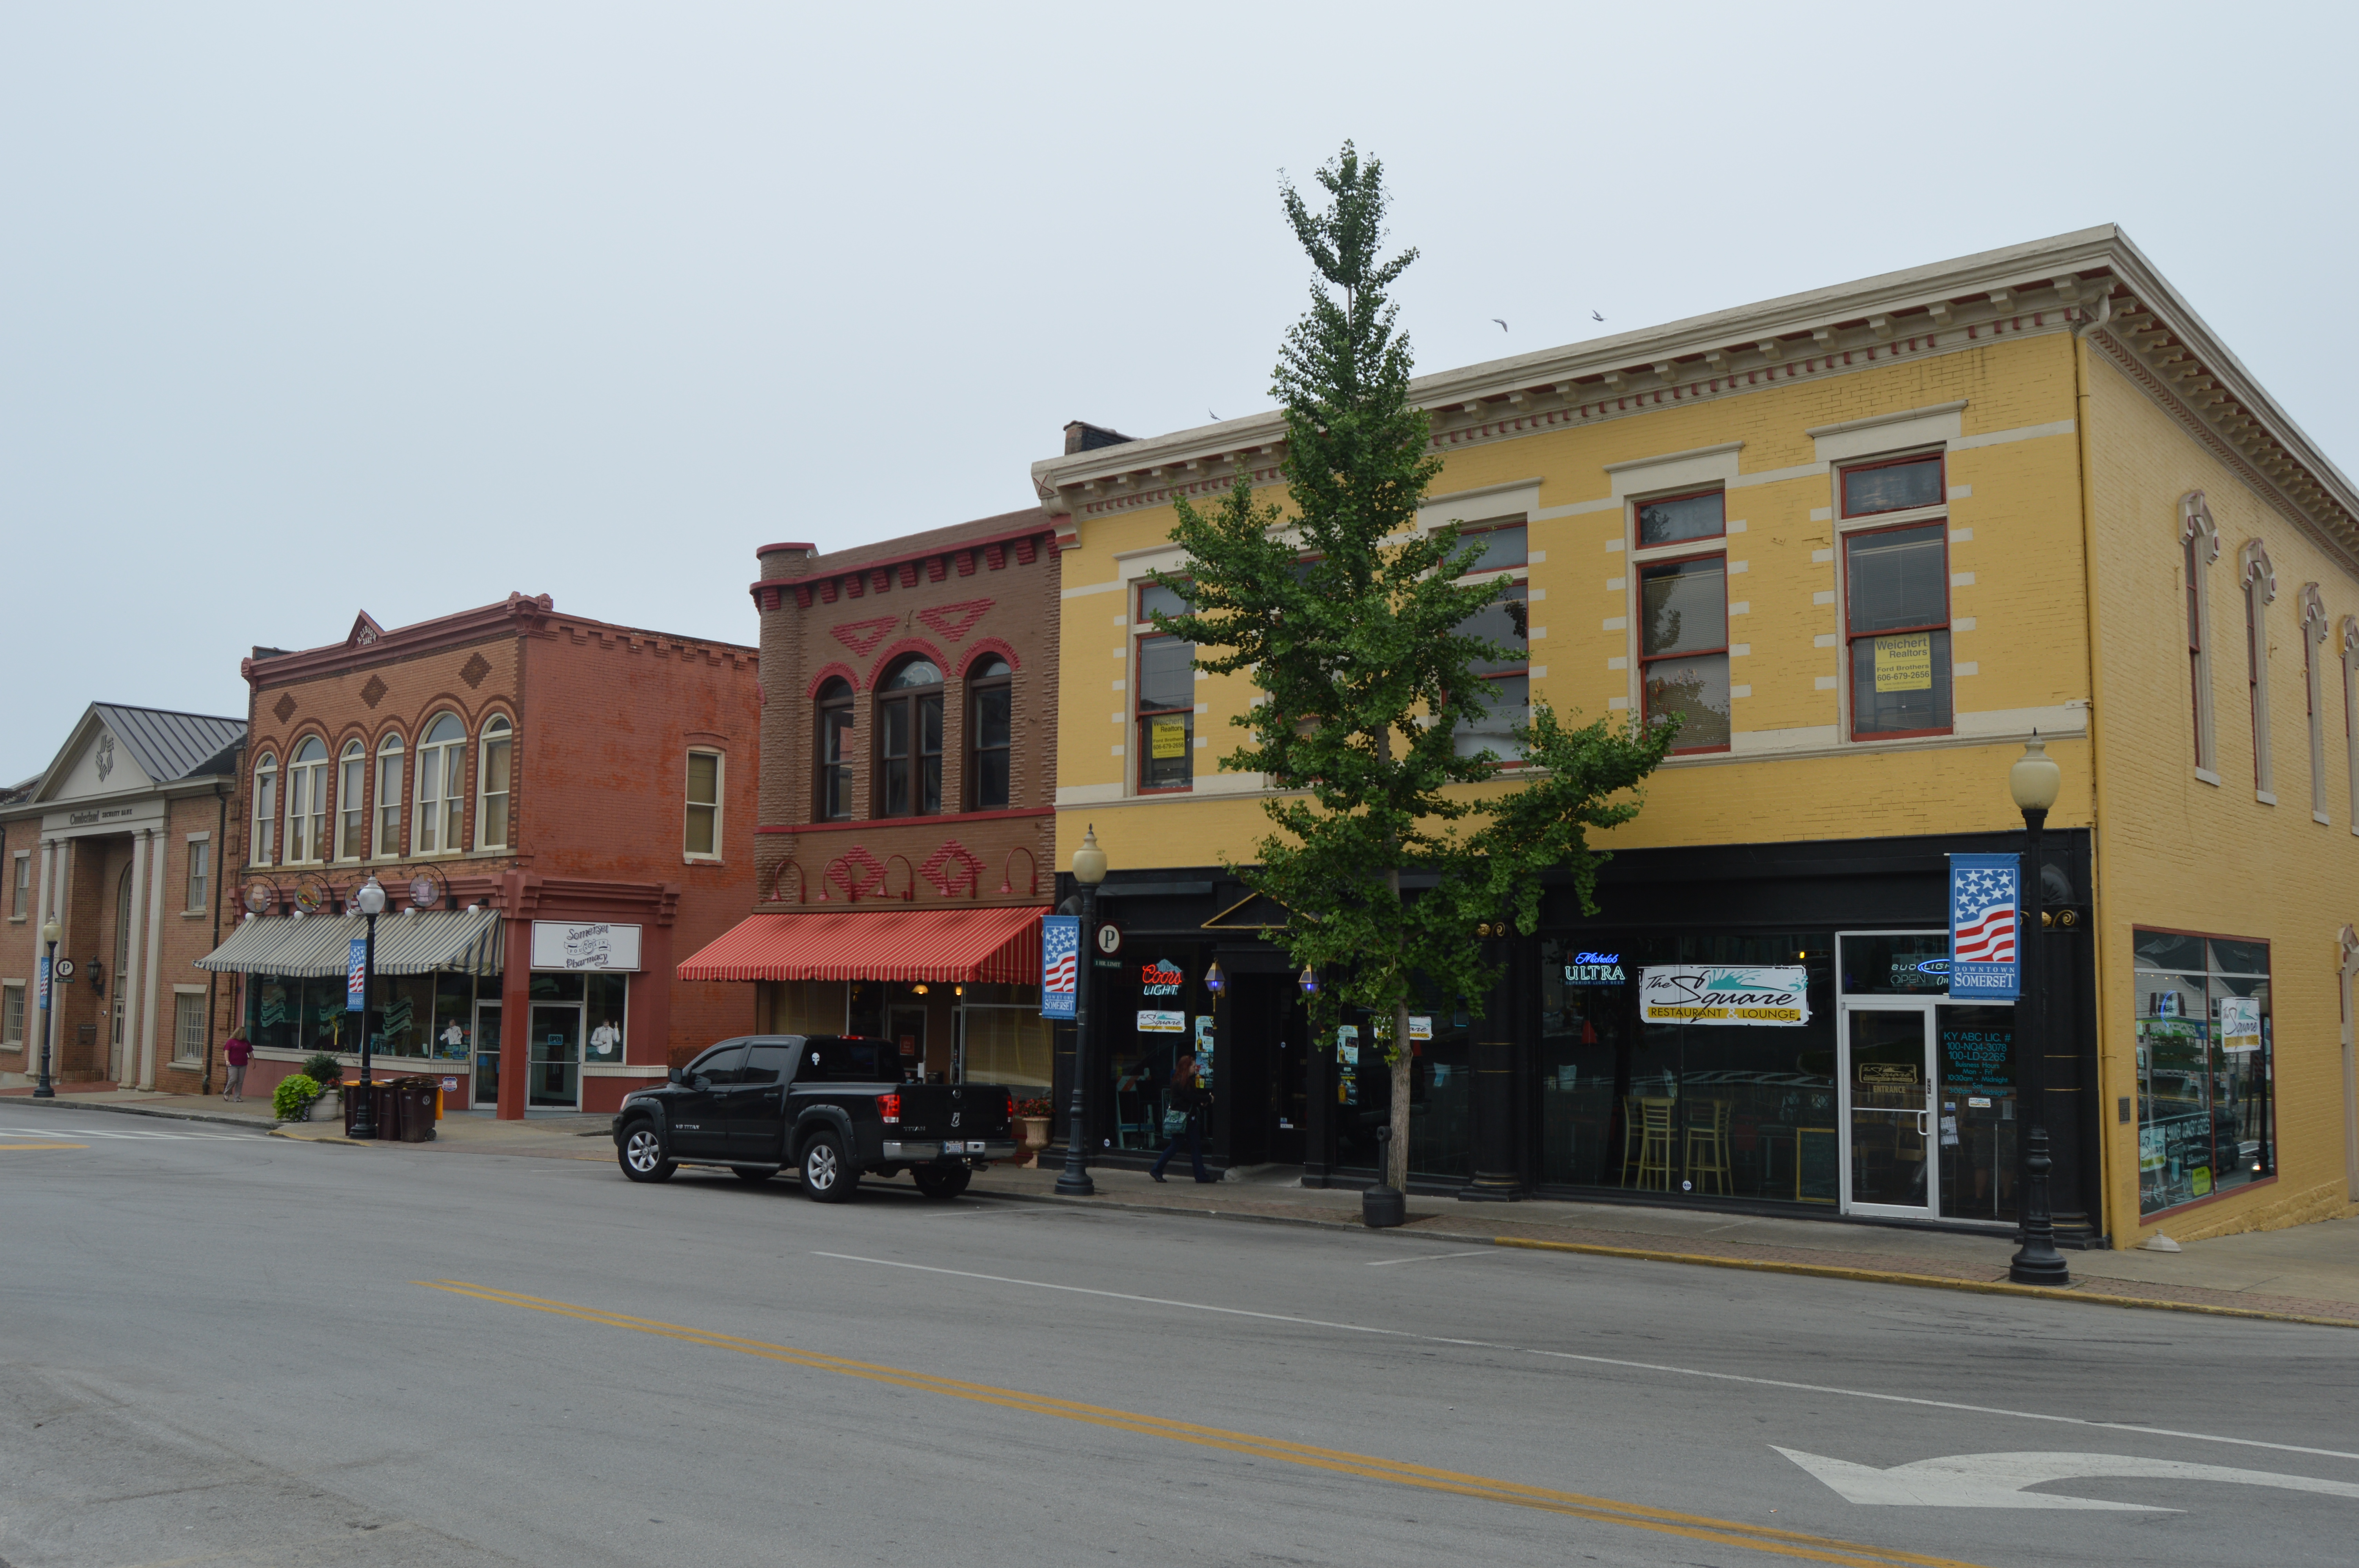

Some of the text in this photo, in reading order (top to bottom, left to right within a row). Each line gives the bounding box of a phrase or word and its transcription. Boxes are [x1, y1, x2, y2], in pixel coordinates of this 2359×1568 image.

[1876, 638, 1927, 650] Weichert
[1890, 649, 1927, 658] Realtors
[1877, 671, 1930, 681] 606-679-2656
[1153, 717, 1183, 726] Weichert
[70, 810, 99, 825] Cumberland
[566, 924, 609, 940] Somerset
[1103, 929, 1115, 949] P
[566, 953, 609, 968] Pharmacy
[1575, 952, 1619, 964] Michelob
[62, 963, 70, 973] P
[1565, 965, 1625, 980] ULTRA
[1142, 964, 1183, 985] Coors
[1890, 974, 1926, 984] OPEN
[1954, 972, 2015, 987] SOMERSET
[1646, 975, 1672, 990] The
[1143, 985, 1179, 995] LIGHT
[1651, 970, 1797, 1023] Square
[1045, 999, 1074, 1011] SOMERSET
[1651, 1007, 1796, 1020] RESTAURANT & LOUNGE
[1141, 1013, 1182, 1031] Square
[1944, 1032, 2011, 1042] KY ABC LIC. #
[1946, 1042, 2007, 1052] 100-NQ4-3078
[1948, 1051, 2006, 1061] 100-LD-2265
[1865, 1066, 1912, 1079] Square
[1873, 1085, 1906, 1094] ENTRANCE
